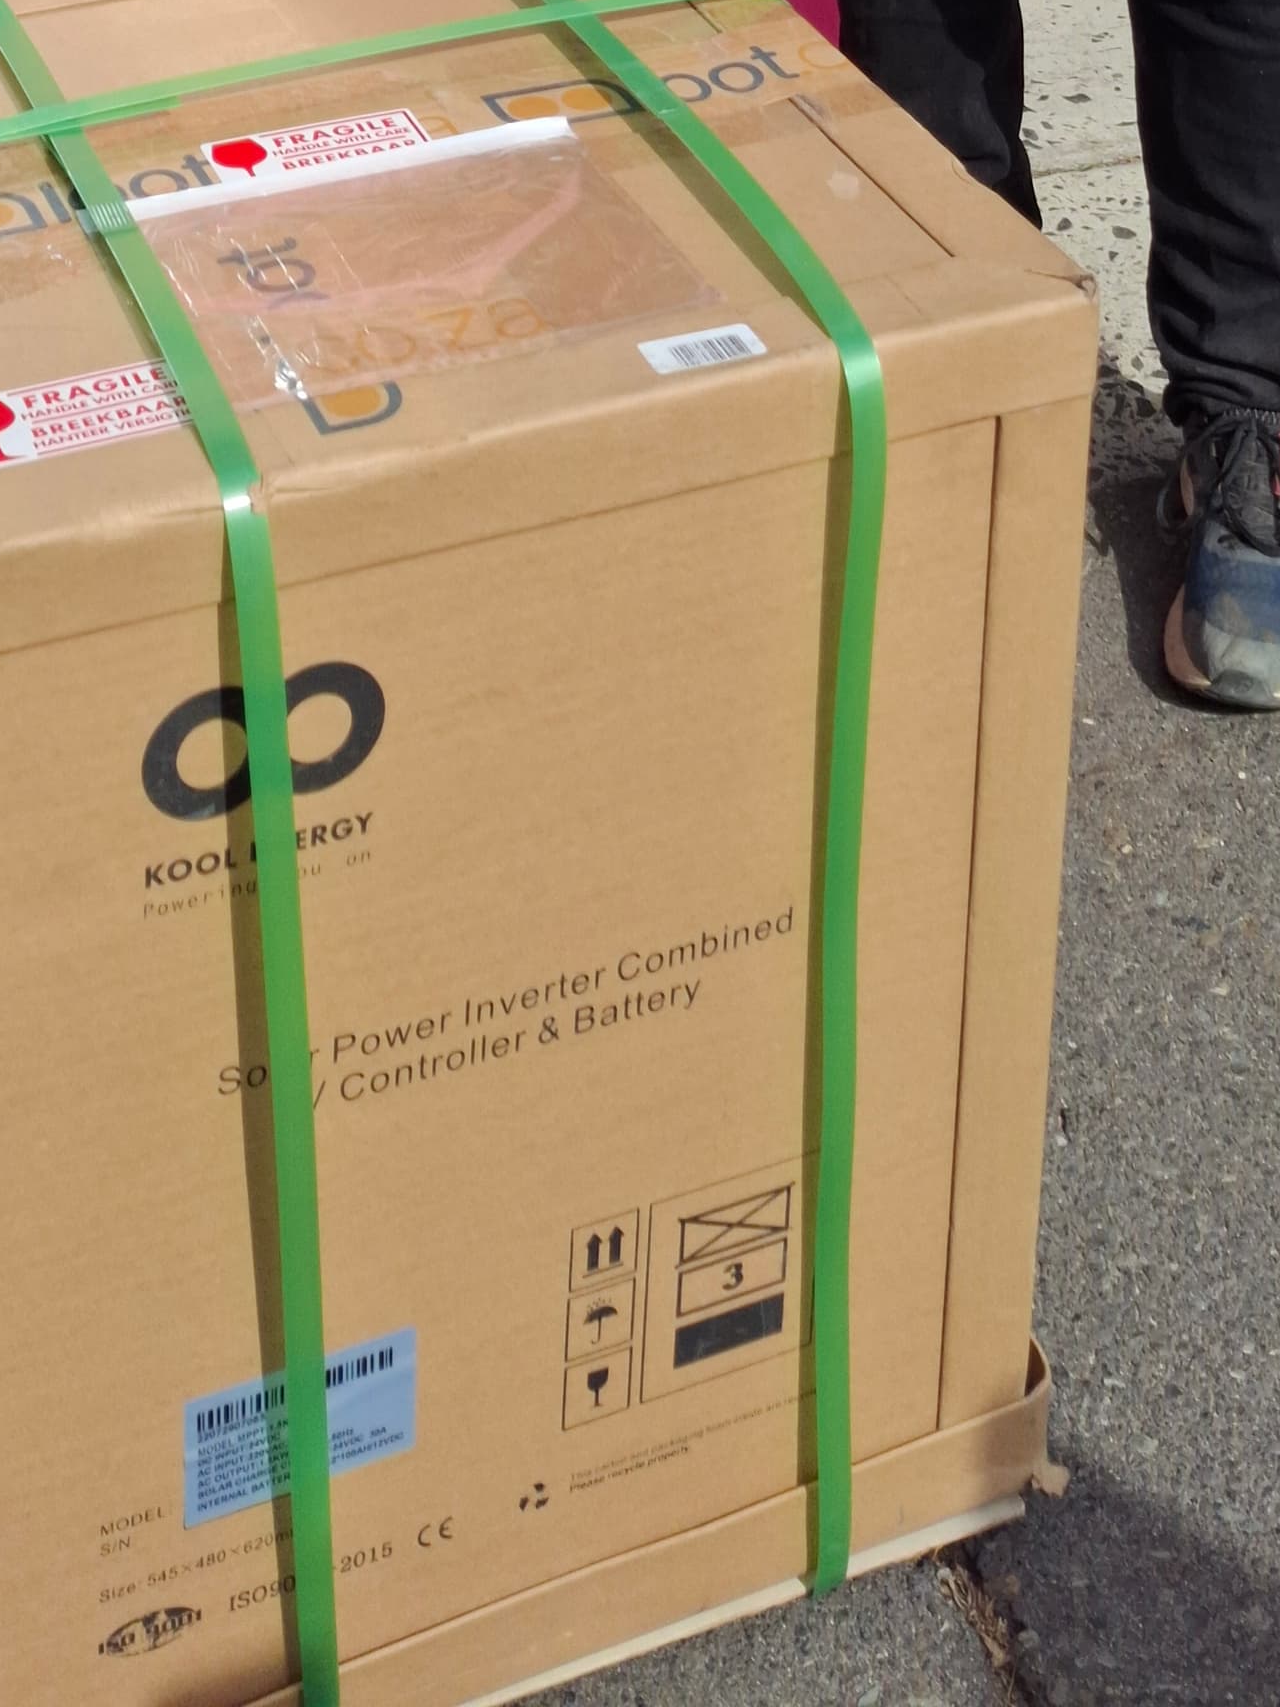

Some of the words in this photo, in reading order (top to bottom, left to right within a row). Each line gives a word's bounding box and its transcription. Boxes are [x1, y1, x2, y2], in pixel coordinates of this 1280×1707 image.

[272, 140, 329, 157] HANDLE
[333, 133, 371, 146] WITH
[375, 125, 412, 138] CARE
[273, 117, 396, 147] FRAGILE
[21, 400, 88, 421] HANDLE
[92, 388, 137, 406] WITH
[141, 379, 178, 394] CAR
[22, 365, 168, 409] FRAGILE
[32, 396, 187, 439] BREEKBAAR
[144, 848, 237, 889] KOOL
[250, 812, 373, 862] ERGY
[332, 1010, 452, 1064] Power
[464, 965, 606, 1026] Inverter
[617, 906, 795, 982] Combined
[339, 1025, 529, 1102] Controller
[538, 1016, 561, 1045] &
[573, 978, 702, 1038] Battery
[722, 1262, 744, 1290] 3
